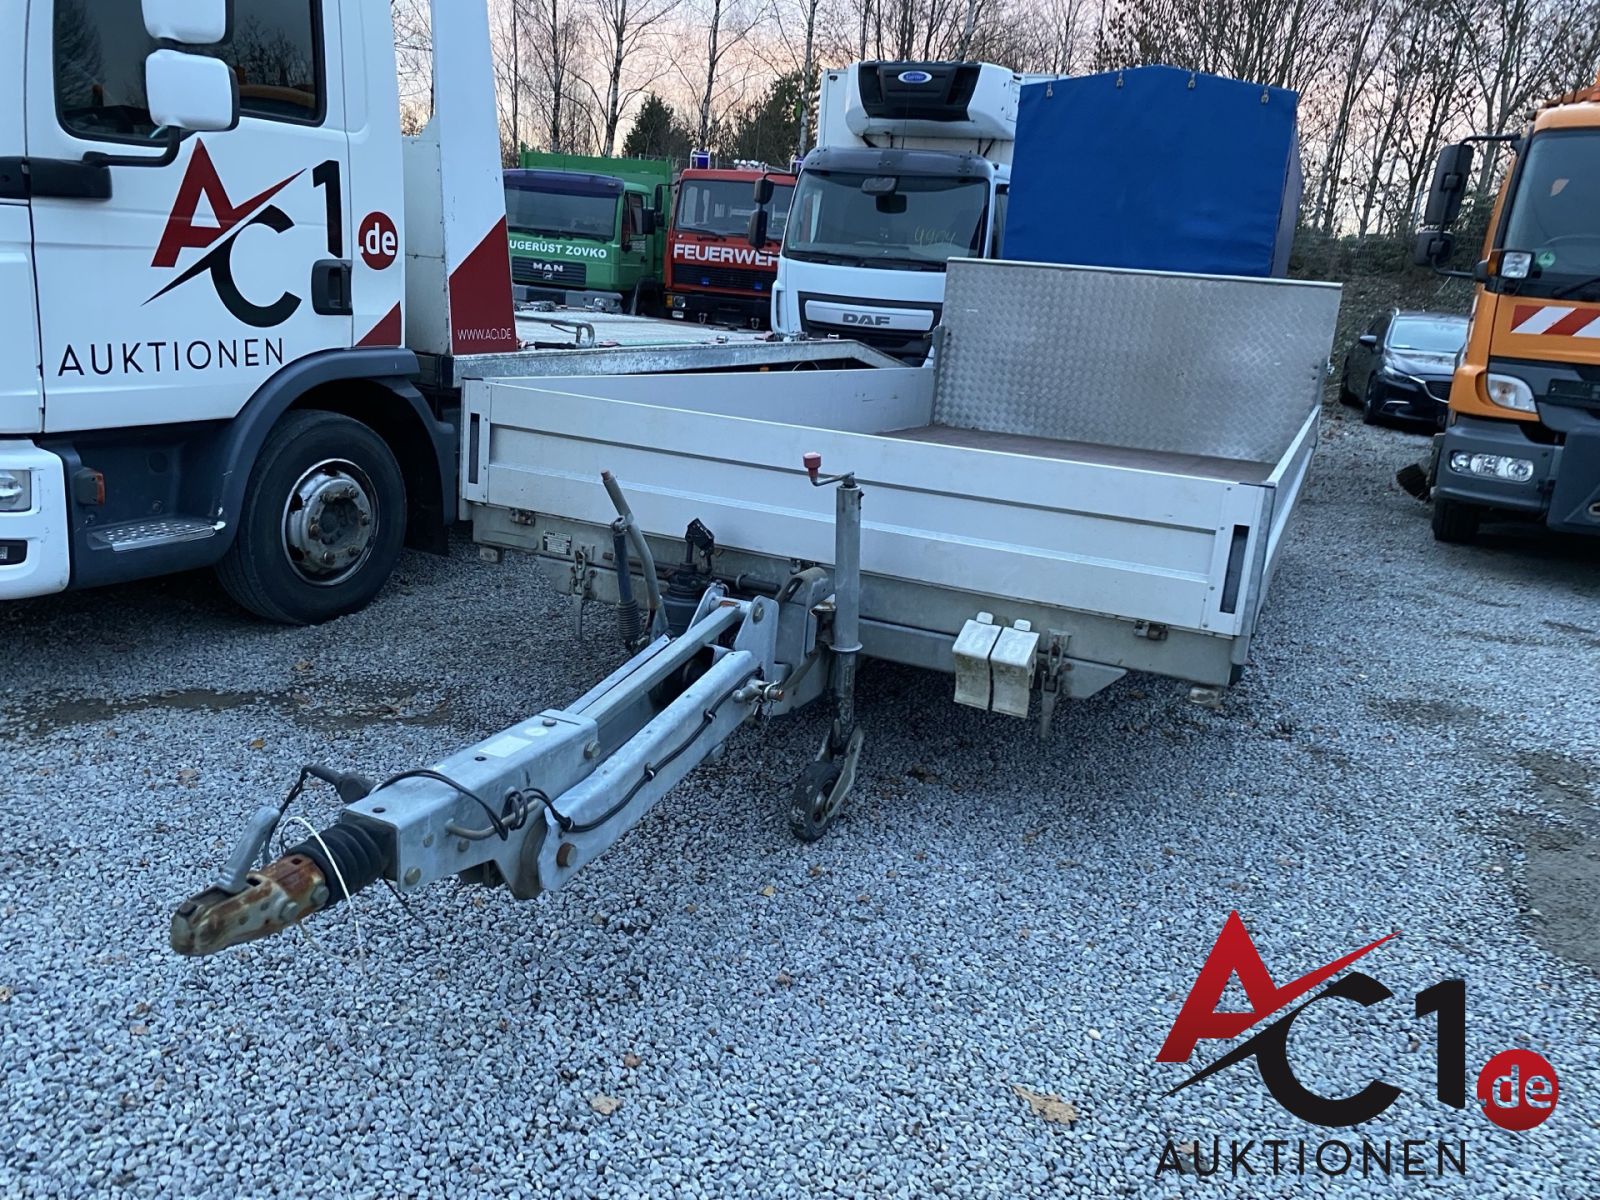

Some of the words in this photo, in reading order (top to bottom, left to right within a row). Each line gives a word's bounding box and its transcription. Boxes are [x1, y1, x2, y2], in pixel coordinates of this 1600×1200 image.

[509, 239, 563, 254] UGERÜST
[565, 245, 607, 259] ZOVKO
[532, 262, 563, 272] MAN
[842, 313, 890, 326] DAF
[57, 337, 284, 377] AUKTIONEN
